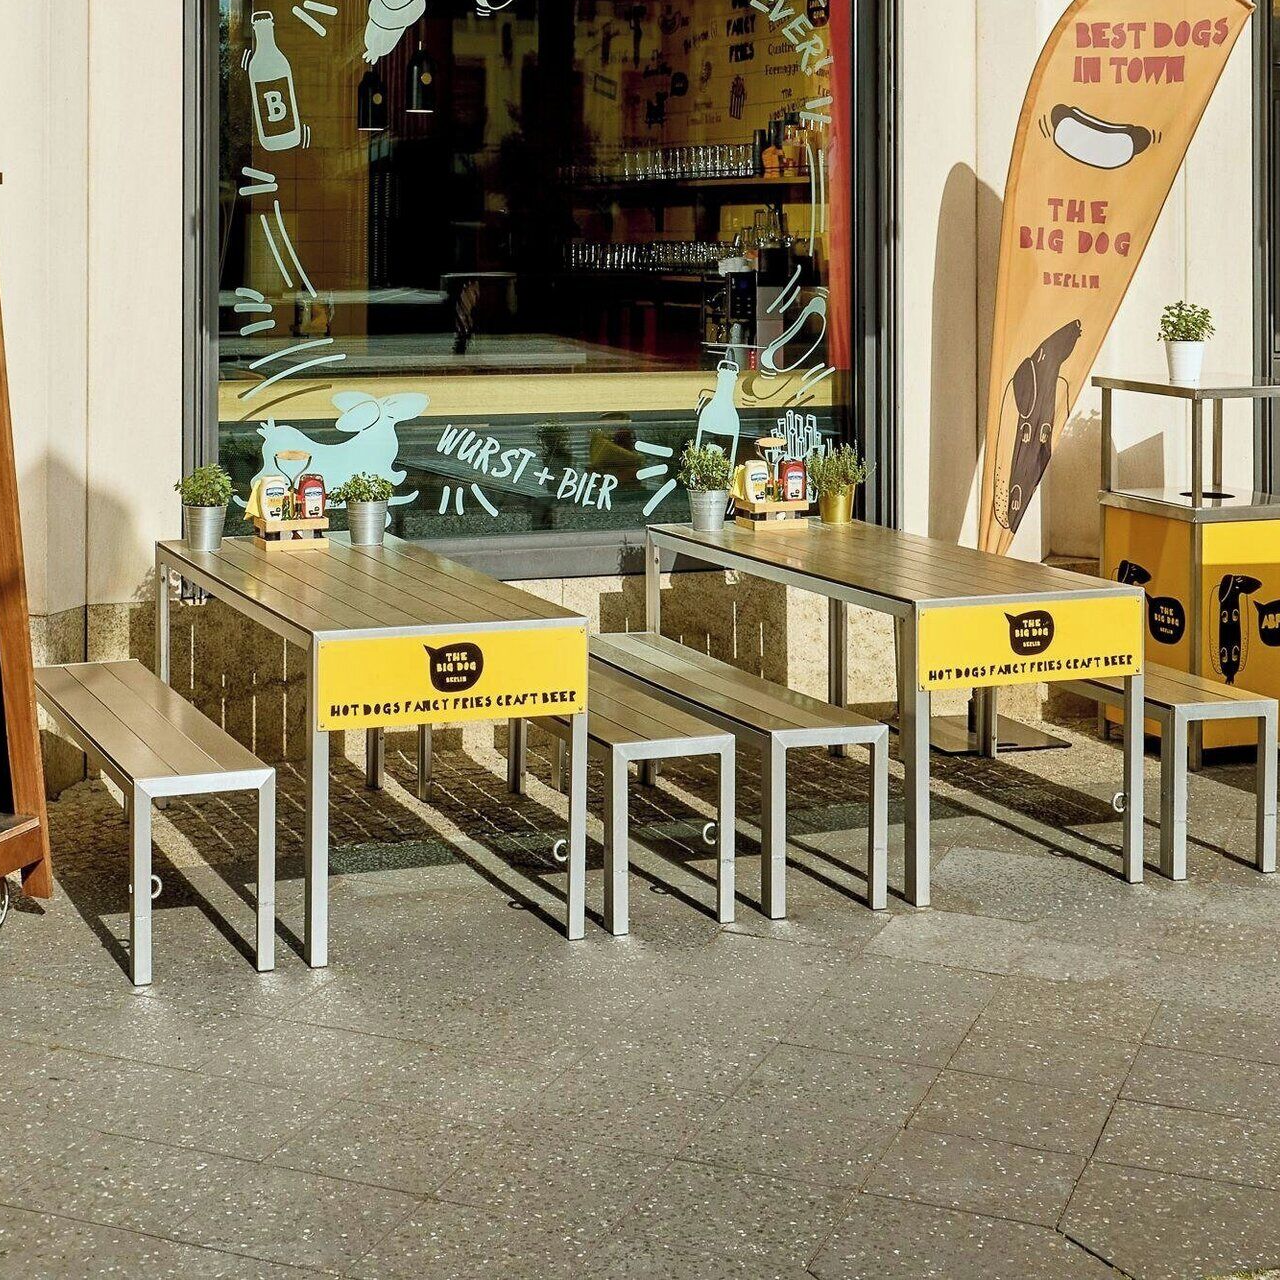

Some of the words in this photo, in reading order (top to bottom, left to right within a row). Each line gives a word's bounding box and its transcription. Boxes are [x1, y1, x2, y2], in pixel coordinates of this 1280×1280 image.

[1075, 22, 1146, 49] BEST
[1154, 17, 1229, 48] DOGS
[1073, 55, 1101, 84] IN
[1109, 55, 1185, 85] TOWN
[264, 91, 287, 122] B
[1048, 197, 1108, 224] THE
[1020, 226, 1064, 253] BIG
[1078, 231, 1131, 257] DOG
[1043, 271, 1100, 289] BERLIN
[437, 424, 536, 484] WURST
[556, 467, 619, 511] BIER
[1022, 619, 1041, 628] THE
[1154, 613, 1165, 623] BIG
[1160, 606, 1174, 616] THE
[1014, 628, 1030, 638] BIG
[1031, 627, 1049, 637] DOG
[436, 663, 454, 673] BIG
[457, 661, 477, 672] DOG
[445, 652, 468, 662] THE
[928, 669, 953, 681] HOT
[955, 666, 987, 679] DOGS
[989, 663, 1027, 676] FANCY
[1030, 659, 1062, 672] FRIES
[1065, 656, 1102, 669] CRAFT
[1104, 654, 1133, 667] BEER
[330, 704, 359, 717] HOT
[363, 701, 400, 716] DOGS
[404, 698, 450, 713] FANCY
[453, 694, 492, 710] FRIES
[496, 692, 538, 707] CRAFT
[541, 690, 577, 703] BEER
